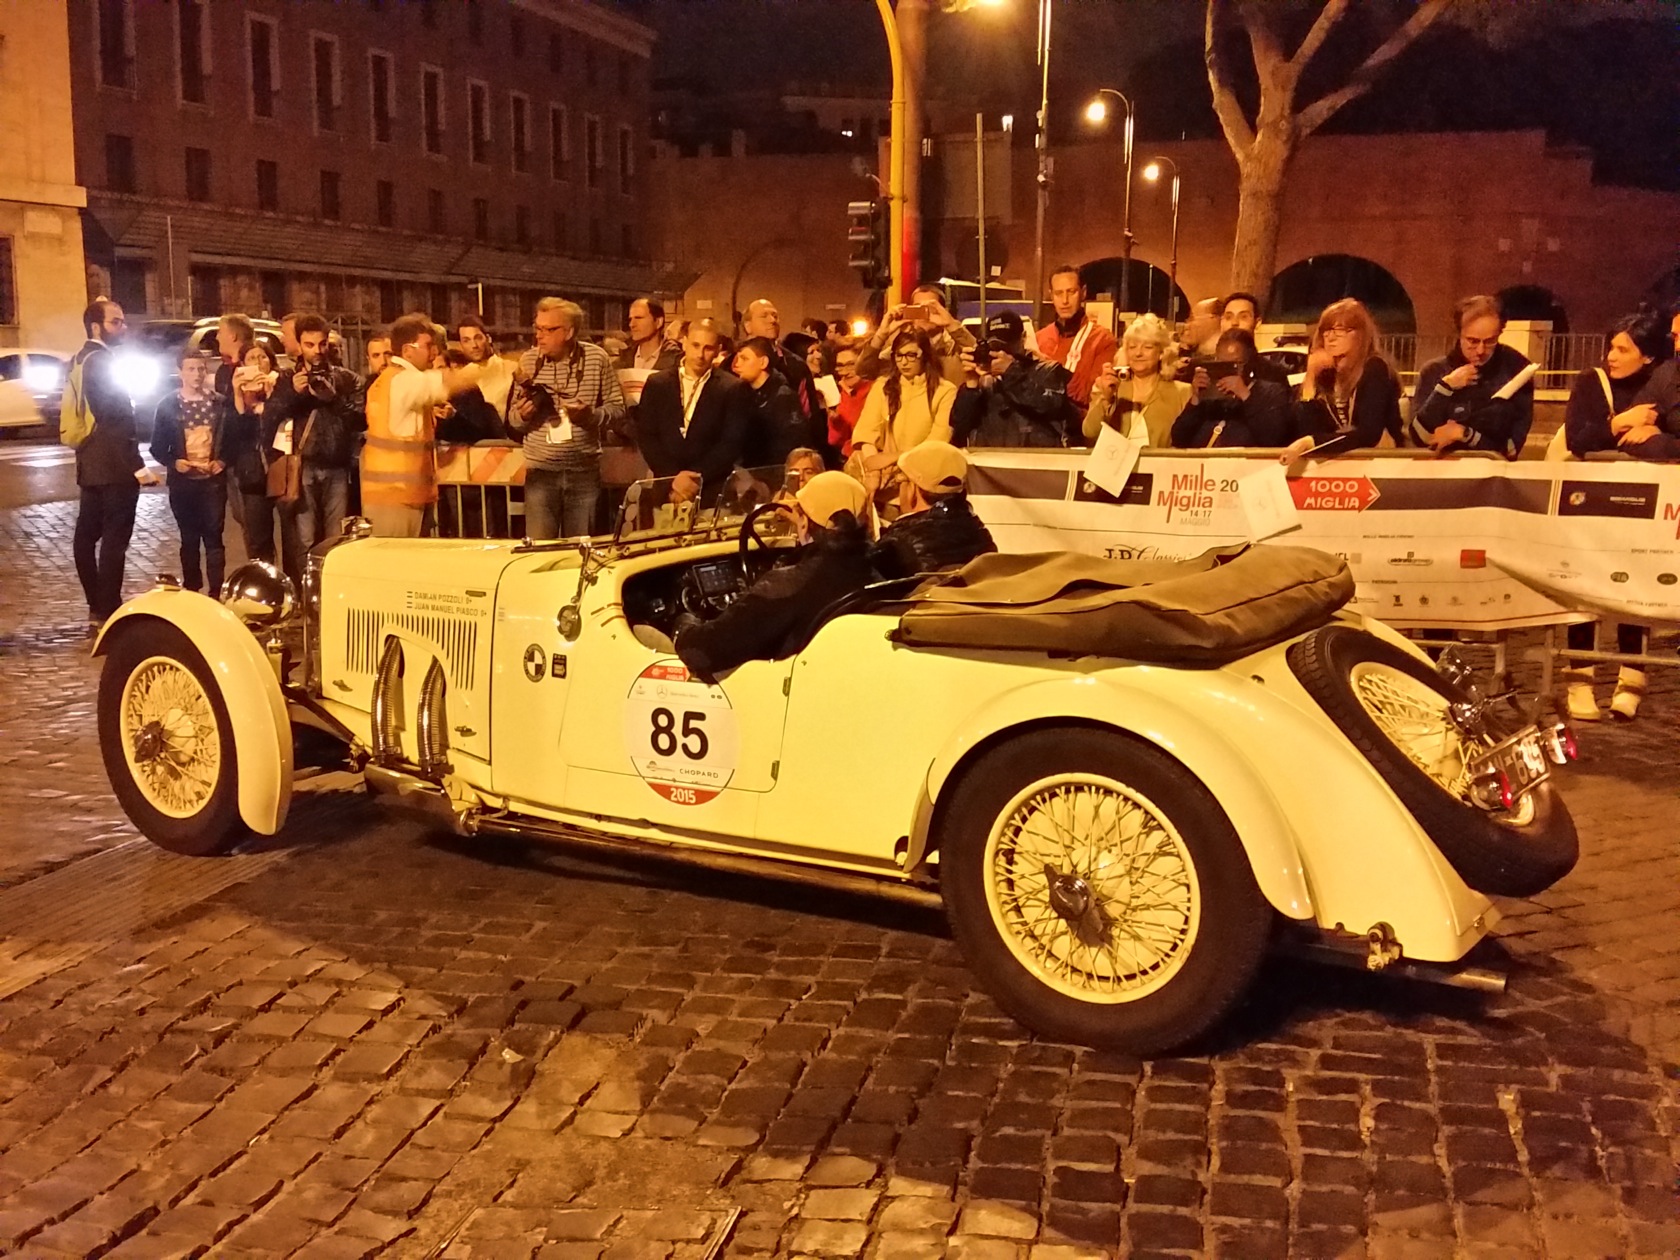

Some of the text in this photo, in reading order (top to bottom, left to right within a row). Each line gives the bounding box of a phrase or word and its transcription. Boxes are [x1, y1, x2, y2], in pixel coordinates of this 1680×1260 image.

[1171, 463, 1216, 491] Mille
[1309, 480, 1358, 493] 1000
[1157, 490, 1213, 523] Miglia
[1303, 497, 1360, 509] MIGLIA
[1203, 510, 1212, 518] 17
[414, 591, 437, 601] DAMIAN
[414, 602, 430, 611] JUAN
[431, 604, 455, 614] MANUEL
[650, 707, 709, 760] 85
[679, 768, 719, 779] CHOPARD
[670, 787, 697, 804] 2015
